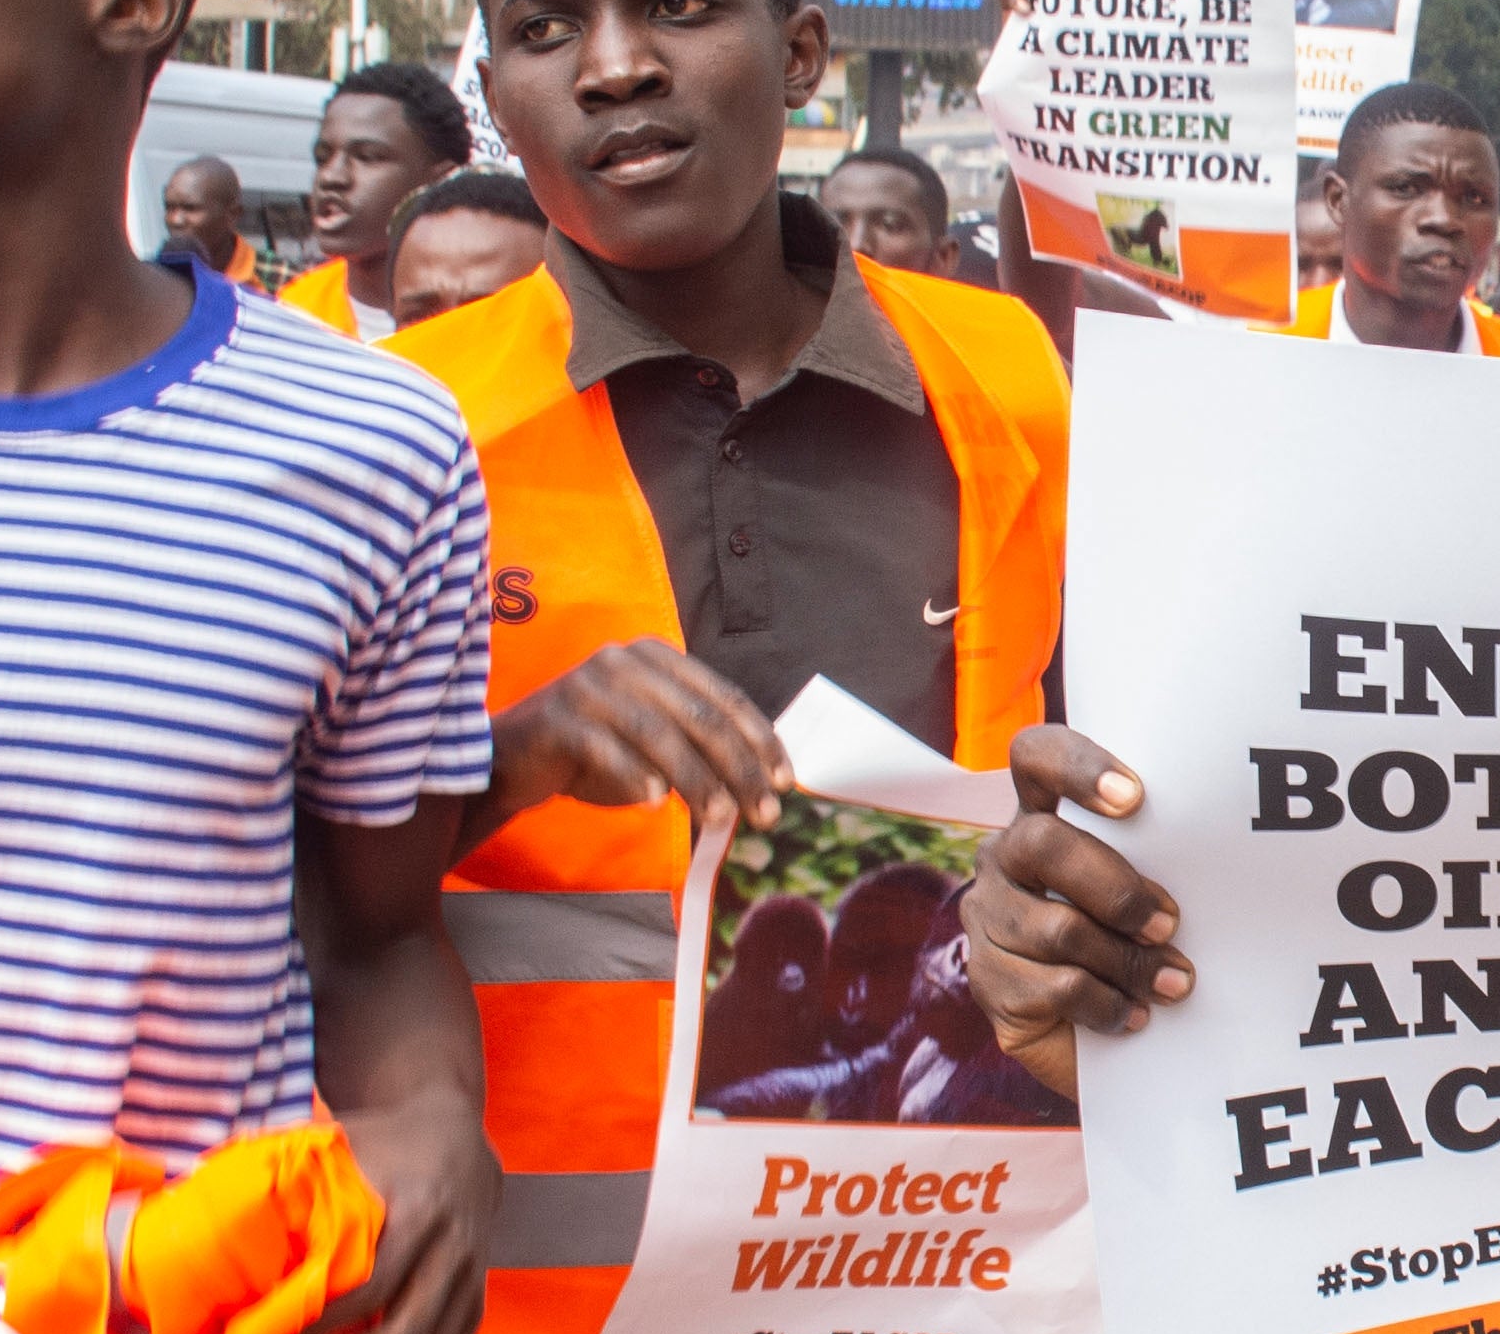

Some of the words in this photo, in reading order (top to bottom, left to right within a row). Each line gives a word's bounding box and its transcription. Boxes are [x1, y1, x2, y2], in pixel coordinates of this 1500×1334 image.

[1019, 23, 1045, 55] A
[1055, 27, 1250, 65] CLIMATE
[1049, 67, 1216, 102] LEADER
[1296, 69, 1365, 96] dlife
[1033, 103, 1077, 133] IN
[1088, 108, 1233, 142] GREEN
[1007, 131, 1273, 185] TRANSITION.
[751, 1154, 1011, 1220] Protect
[730, 1228, 1012, 1294] Wildlife
